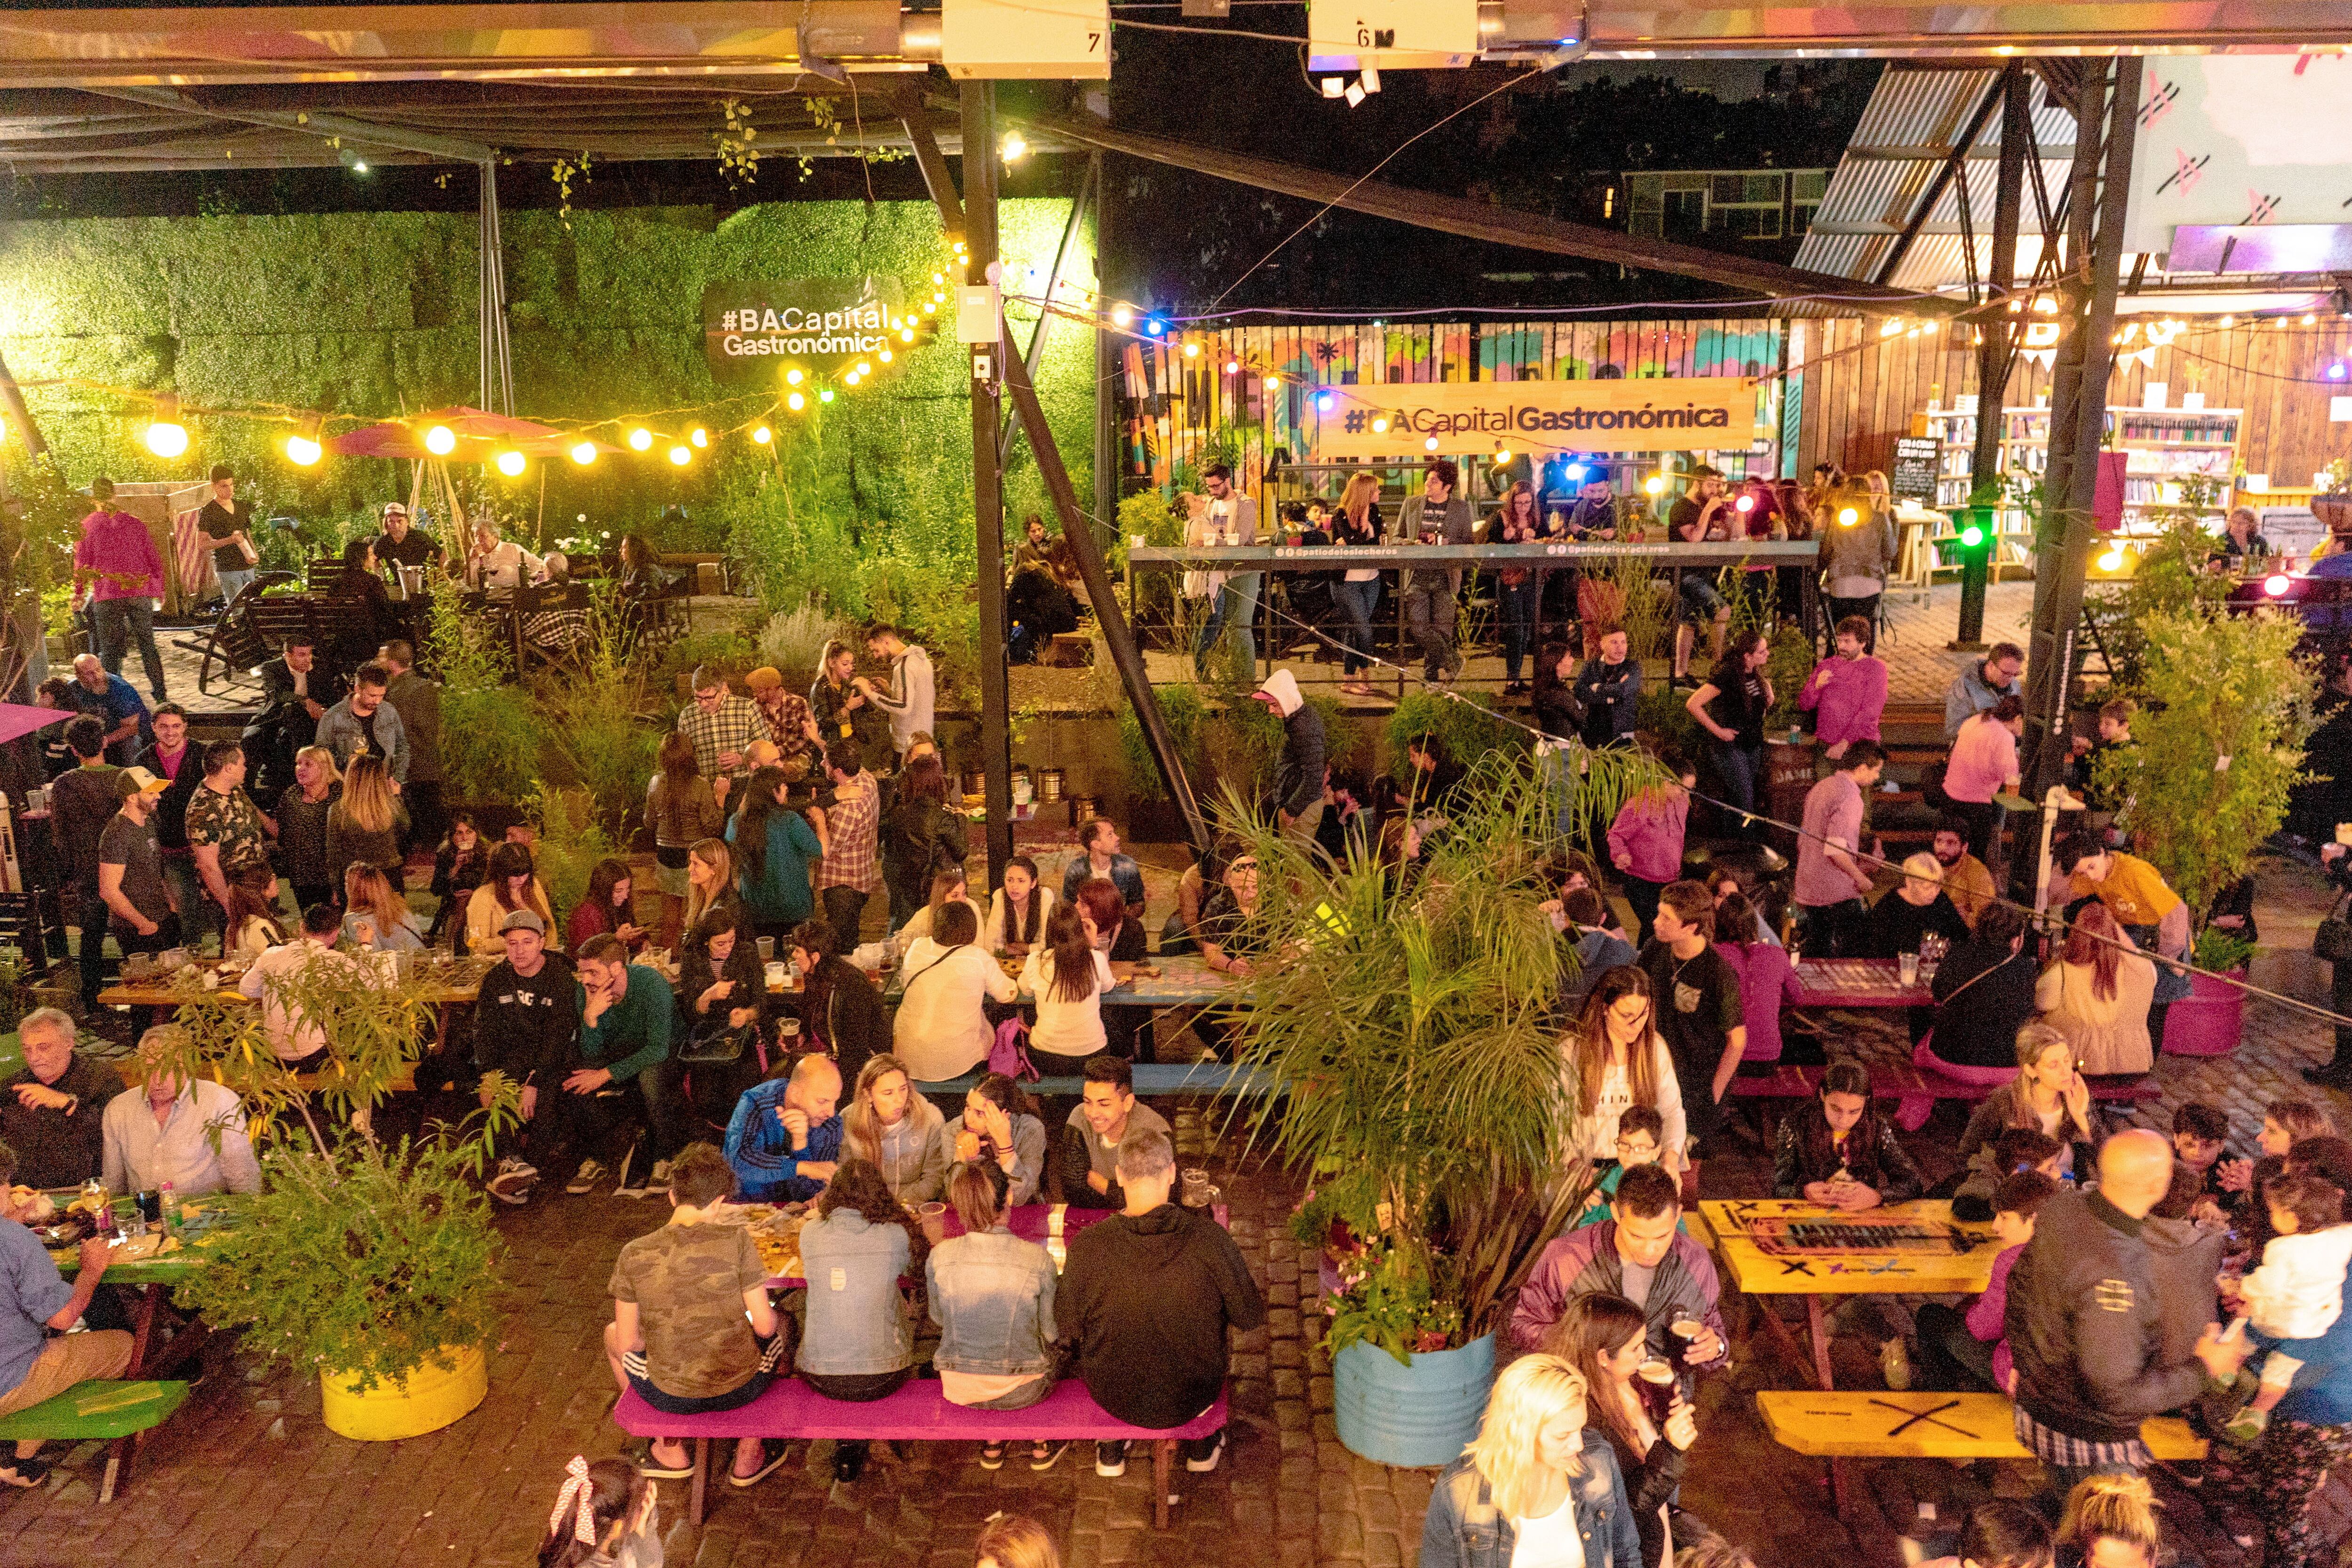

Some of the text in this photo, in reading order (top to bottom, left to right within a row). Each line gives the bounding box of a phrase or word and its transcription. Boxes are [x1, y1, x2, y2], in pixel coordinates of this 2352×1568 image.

[1089, 33, 1100, 52] 7
[1358, 29, 1370, 48] 6
[722, 303, 888, 336] #BACapital
[723, 331, 889, 356] Gastronómica
